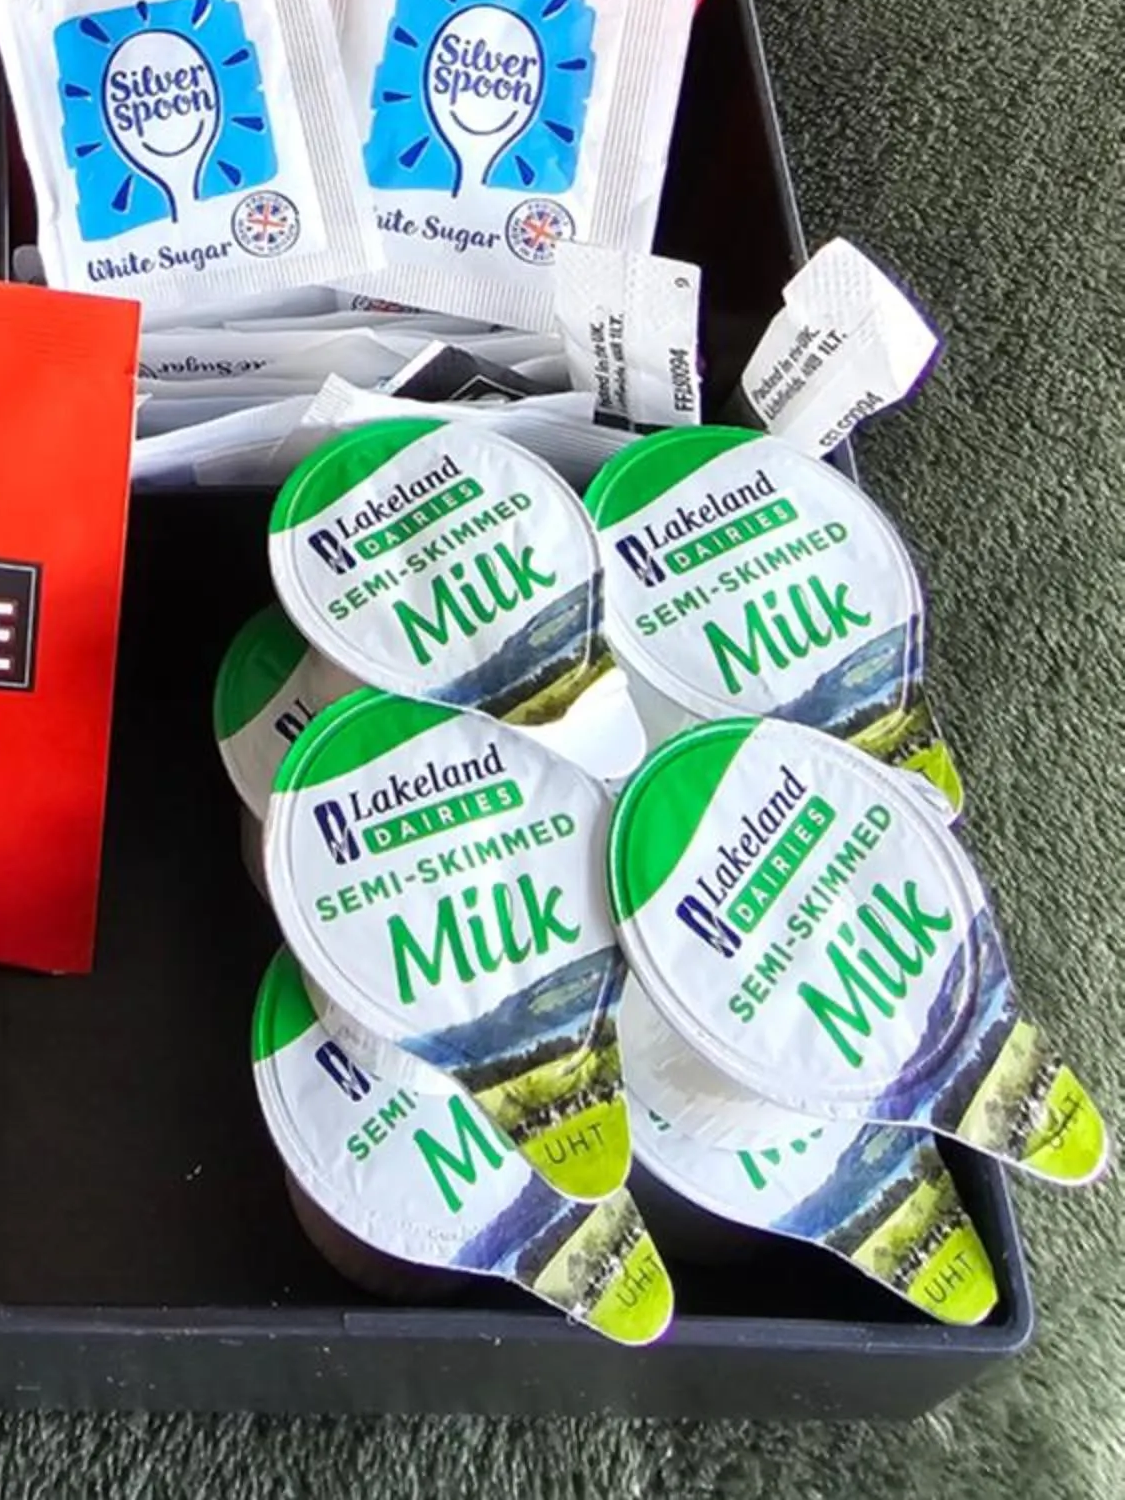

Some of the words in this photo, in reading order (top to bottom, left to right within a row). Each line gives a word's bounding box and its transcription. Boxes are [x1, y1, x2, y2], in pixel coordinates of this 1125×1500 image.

[109, 62, 207, 104] Silver
[433, 65, 534, 107] spoon
[437, 33, 538, 79] Silver
[112, 87, 217, 138] spoon
[86, 252, 158, 284] White
[158, 239, 235, 273] Sugar
[421, 214, 502, 253] Sugar
[335, 454, 463, 542] Lakeland
[363, 483, 476, 556] DAIRIES
[644, 468, 778, 551] Lakeland
[675, 502, 795, 570] DAIRIES
[327, 491, 533, 622] SEMI-SKIMMED
[634, 520, 849, 638] SEMI-SKIMMED
[392, 541, 558, 667] Milk
[702, 573, 873, 697] Milk
[350, 742, 507, 823] Lakeland
[374, 786, 515, 848] DAIRIES
[314, 811, 578, 924] SEMI-SKIMMED
[694, 762, 810, 909] Lakeland
[738, 806, 829, 926] DAIRIES
[386, 872, 583, 1006] Milk
[728, 802, 895, 1025] SEMI-SKIMMED
[796, 878, 955, 1070] Milk
[542, 1122, 606, 1167] UHT
[614, 1254, 664, 1311] UHT
[922, 1250, 976, 1307] UHT
